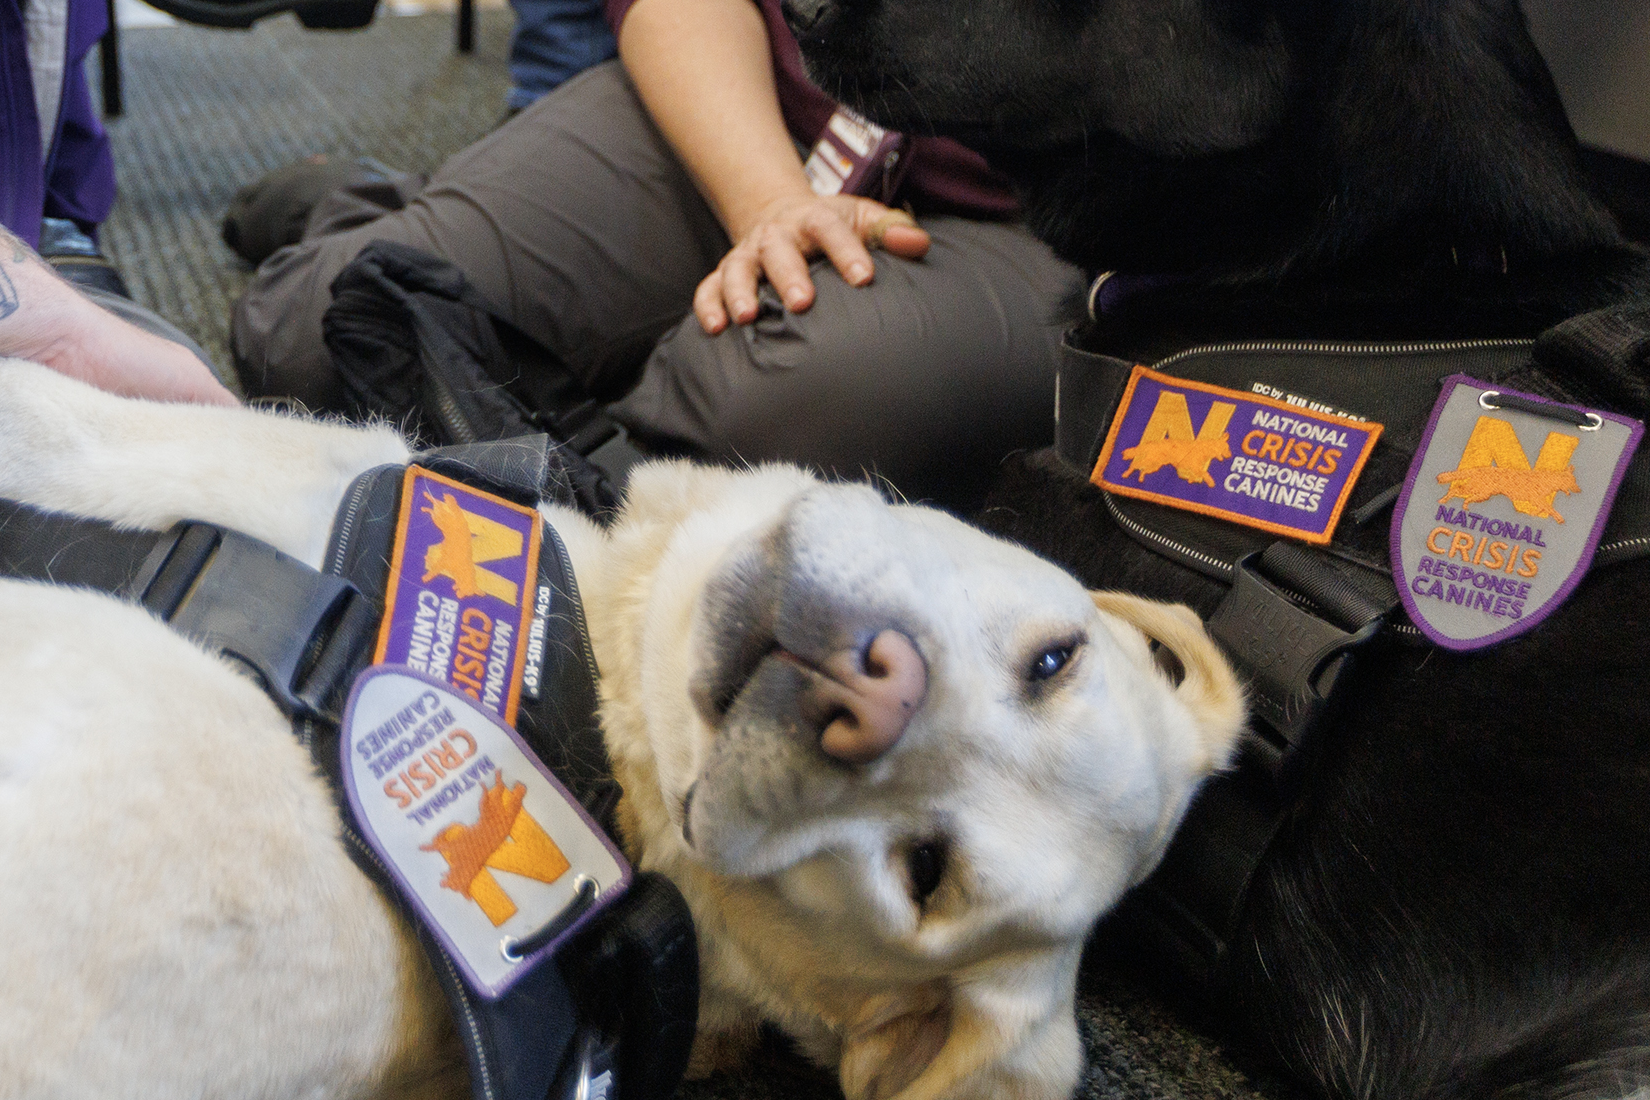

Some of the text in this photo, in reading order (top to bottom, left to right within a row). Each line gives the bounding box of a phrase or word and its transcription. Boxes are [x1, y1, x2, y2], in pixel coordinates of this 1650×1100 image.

[1252, 382, 1271, 395] IDC
[1270, 388, 1284, 400] by
[1251, 409, 1348, 448] NATIONAL
[1241, 429, 1343, 475] CRISIS
[1223, 473, 1322, 513] CANINES
[1230, 456, 1329, 494] RESPONSE
[1435, 504, 1546, 548] NATIONAL
[1426, 526, 1543, 578] CRISIS
[538, 585, 550, 604] IDC
[1411, 575, 1525, 620] CANINES
[1417, 555, 1532, 600] RESPONSE
[407, 590, 440, 673] CANINE
[535, 603, 549, 616] by
[428, 597, 459, 681] RESPONS
[355, 689, 441, 761] CANINES
[367, 705, 457, 781] RESPONSE
[383, 727, 479, 810] CRISIS
[406, 754, 496, 826] NATIONAL
